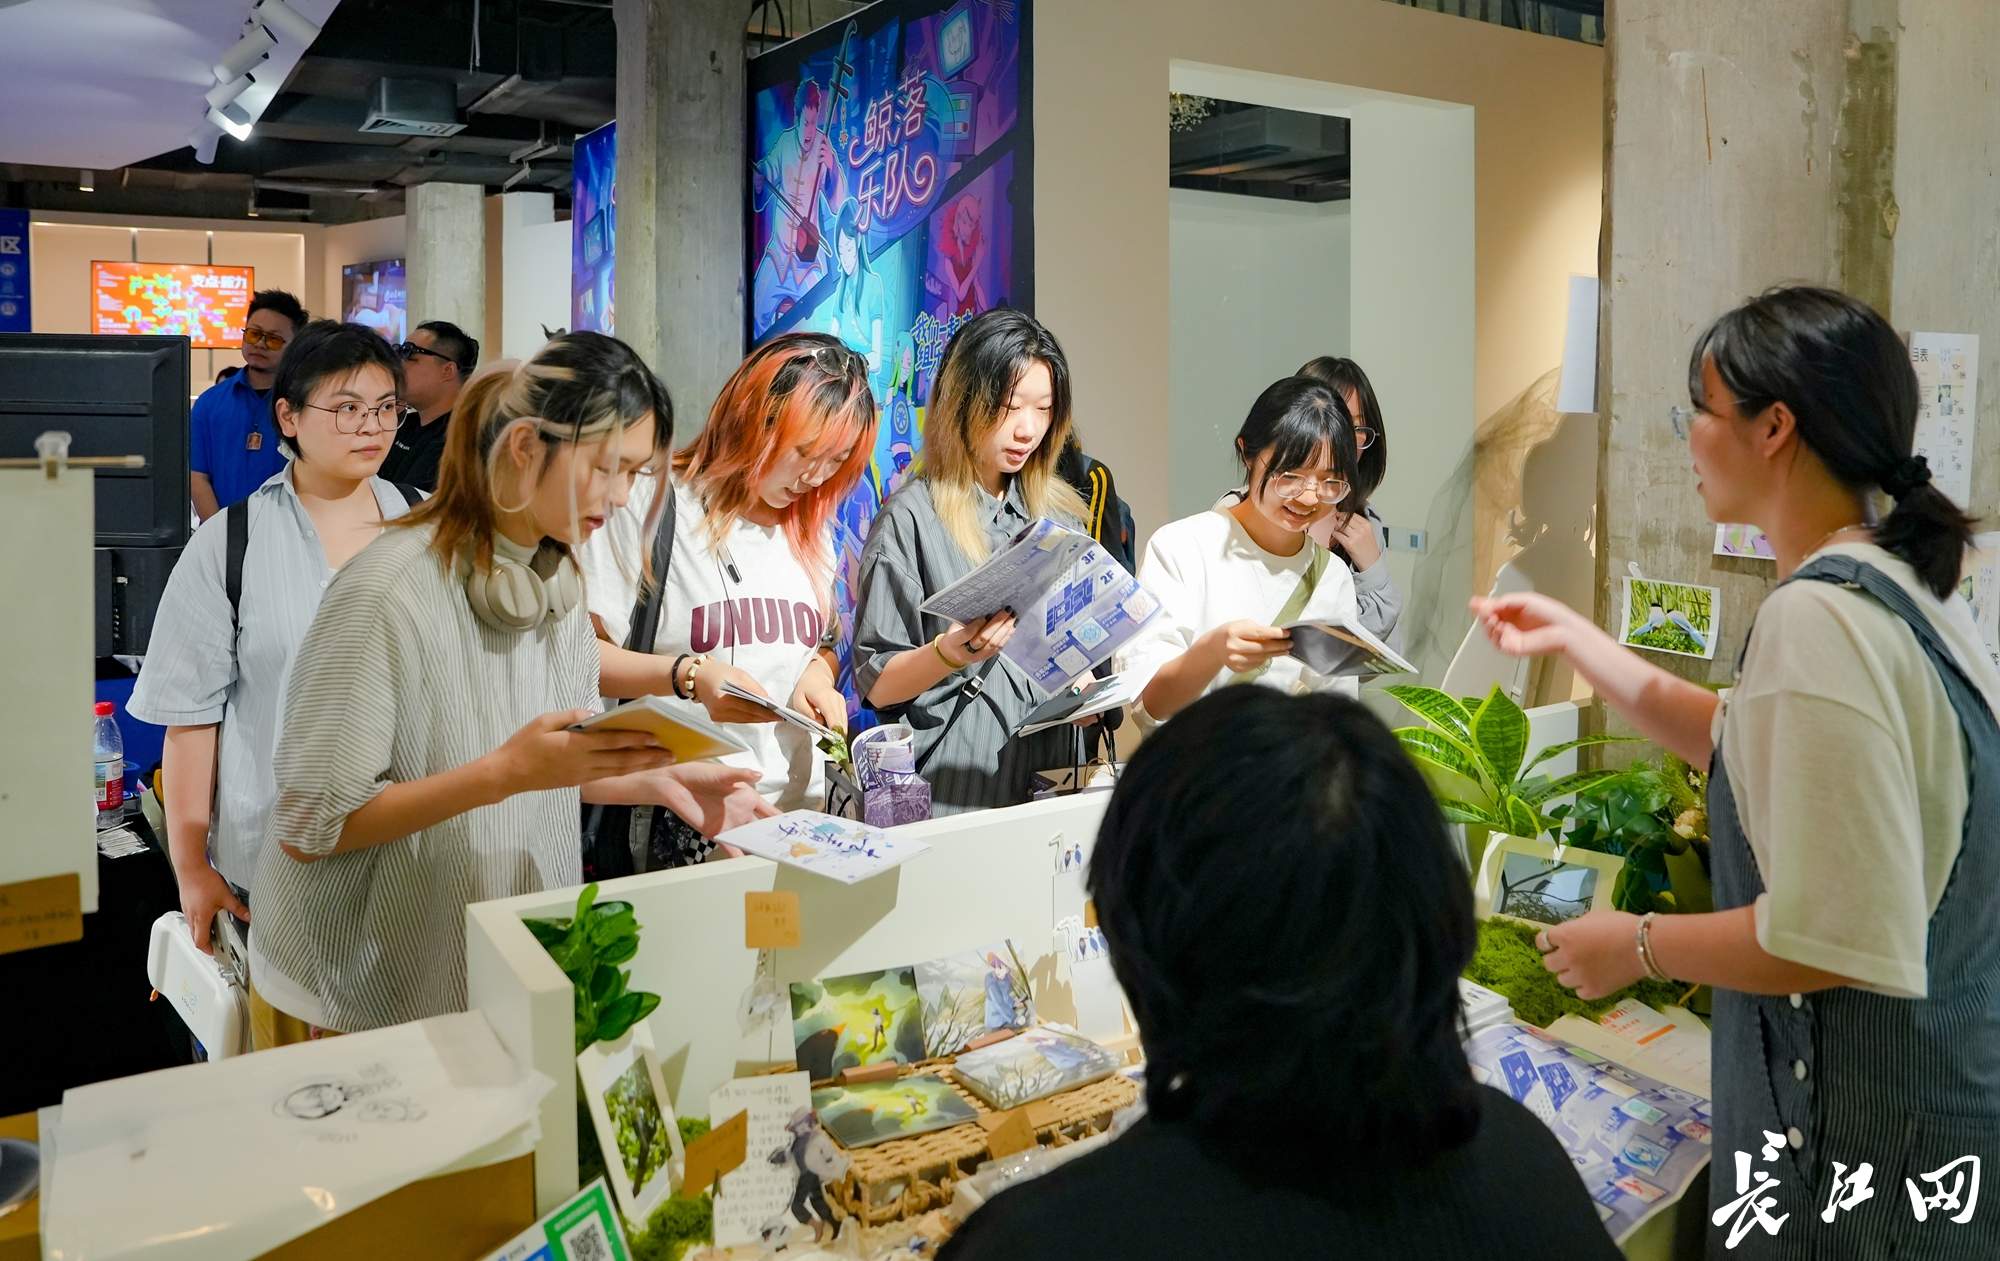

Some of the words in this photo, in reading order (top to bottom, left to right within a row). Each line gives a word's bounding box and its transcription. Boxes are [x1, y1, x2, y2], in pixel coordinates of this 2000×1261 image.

[849, 70, 928, 167] 鲸落
[855, 144, 936, 232] 乐队
[1081, 550, 1095, 565] 3F
[1100, 570, 1114, 585] 2F
